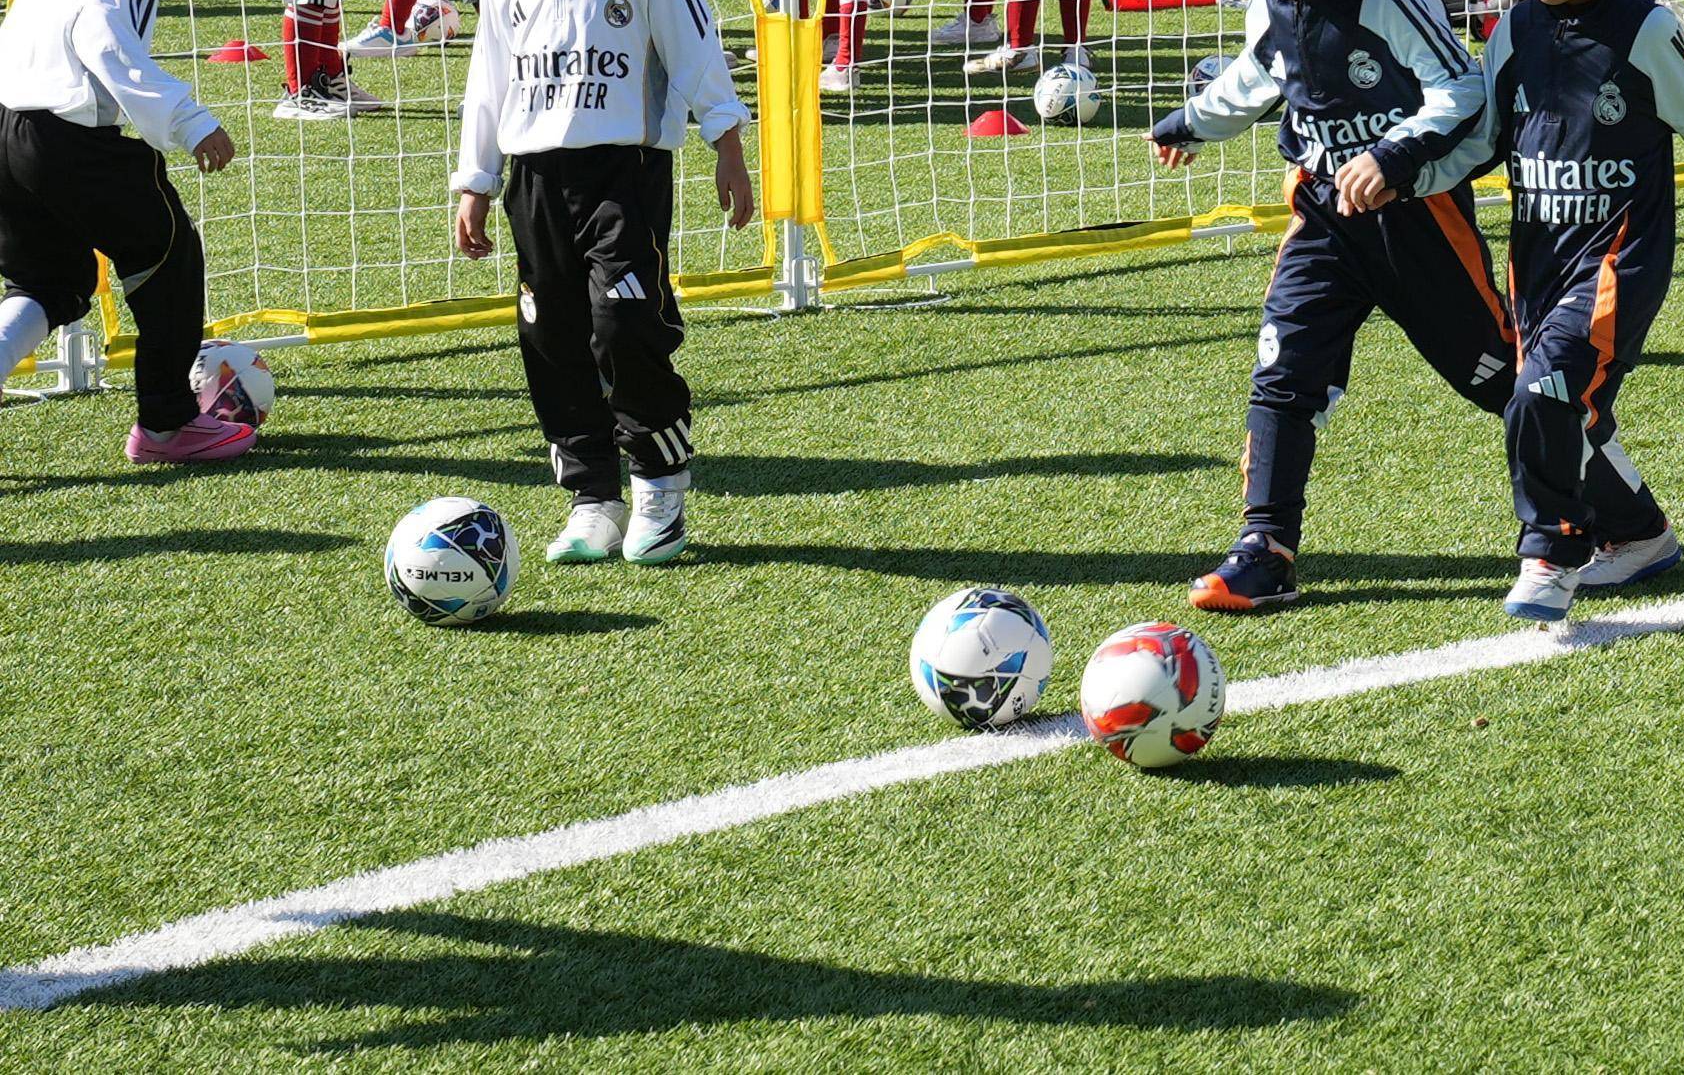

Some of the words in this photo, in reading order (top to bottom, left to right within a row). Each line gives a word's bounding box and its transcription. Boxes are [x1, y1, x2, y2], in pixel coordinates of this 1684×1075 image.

[512, 44, 630, 82] mirates
[545, 82, 609, 111] BETER
[1292, 107, 1406, 149] irates
[1511, 150, 1637, 190] Emirates
[1517, 192, 1536, 224] FY
[1540, 193, 1612, 224] BETTER
[415, 569, 474, 583] KELME
